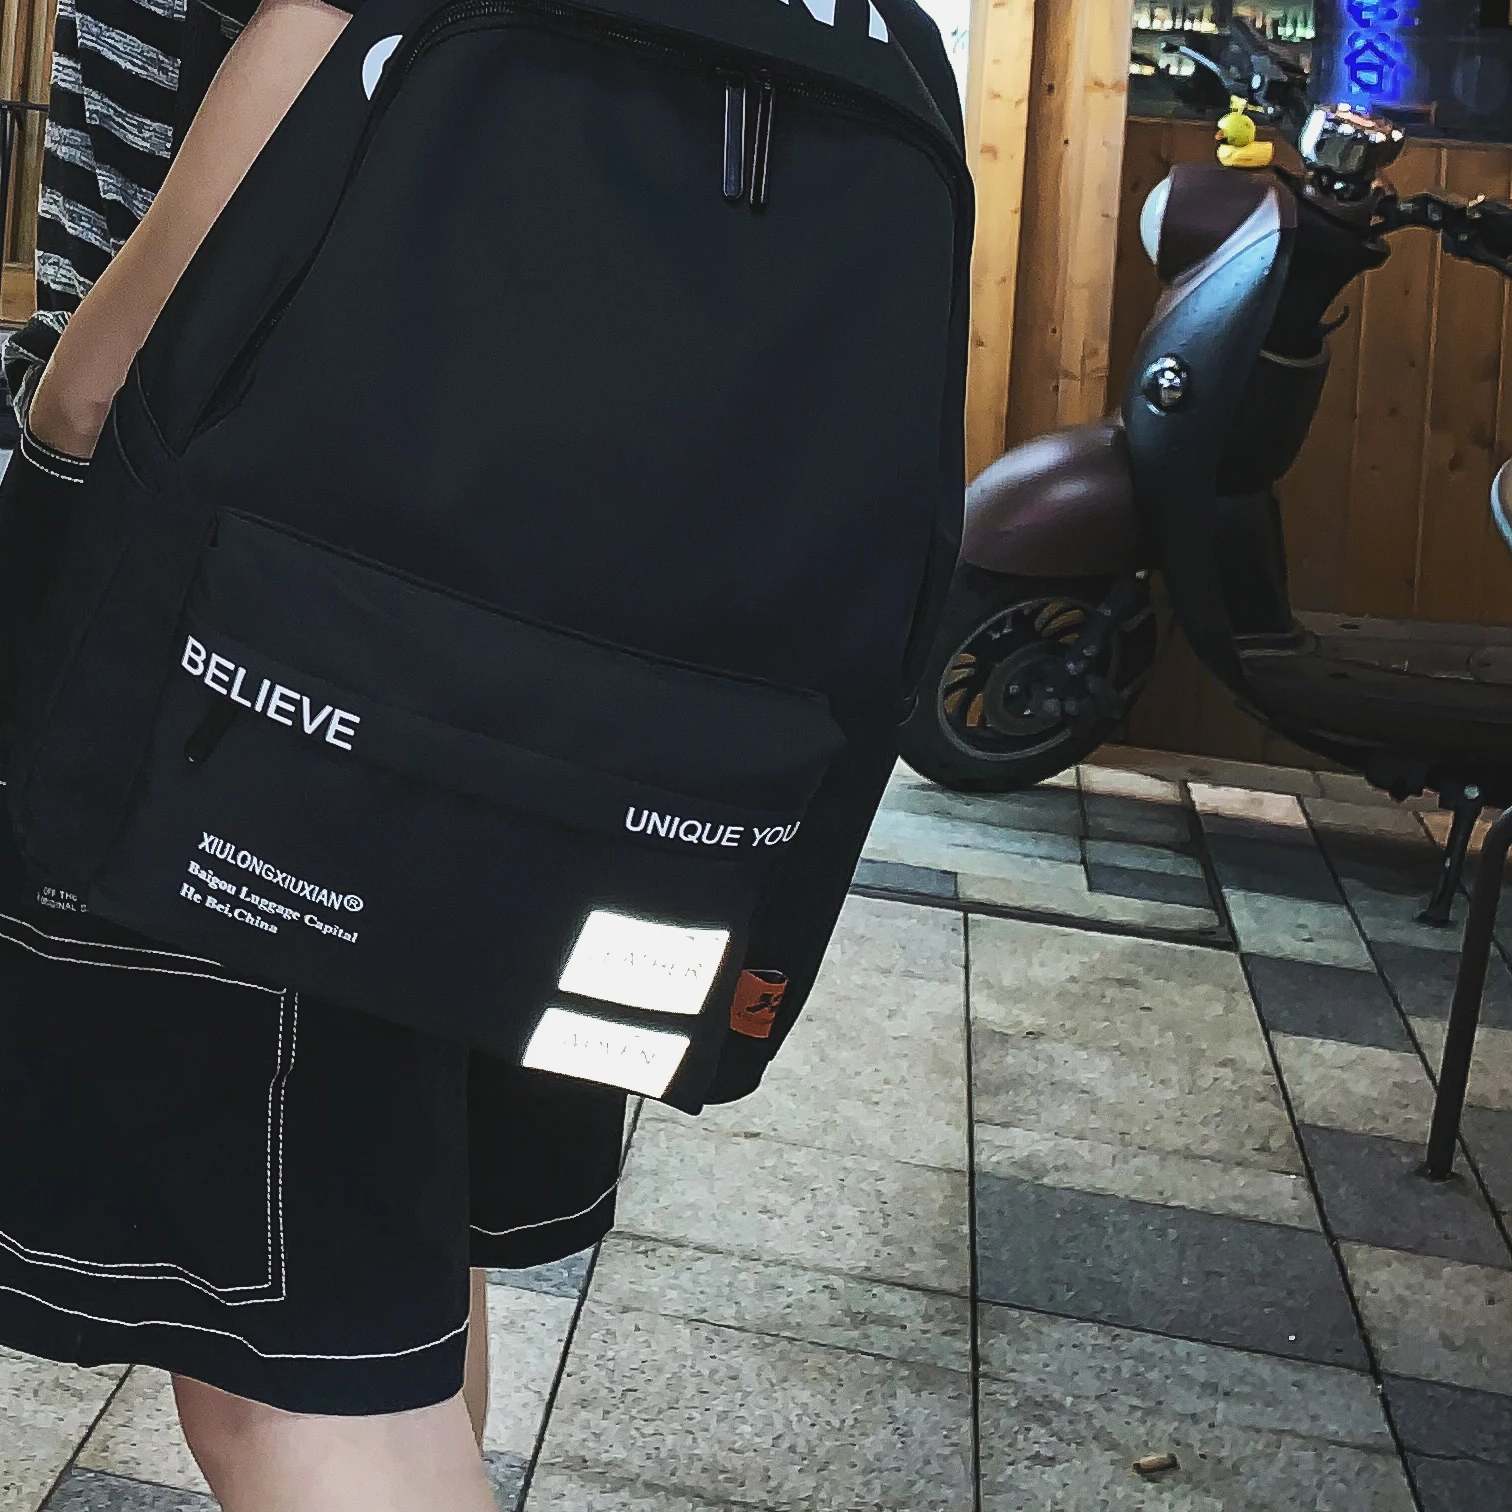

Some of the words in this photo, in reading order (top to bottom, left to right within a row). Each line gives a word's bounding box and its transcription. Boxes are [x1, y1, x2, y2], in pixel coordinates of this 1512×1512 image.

[181, 634, 361, 751] BELIEVE
[625, 806, 745, 847] UNIQUE
[751, 821, 801, 847] YOU
[179, 882, 202, 904] He
[239, 886, 301, 921] Luggage
[304, 914, 359, 944] Capital
